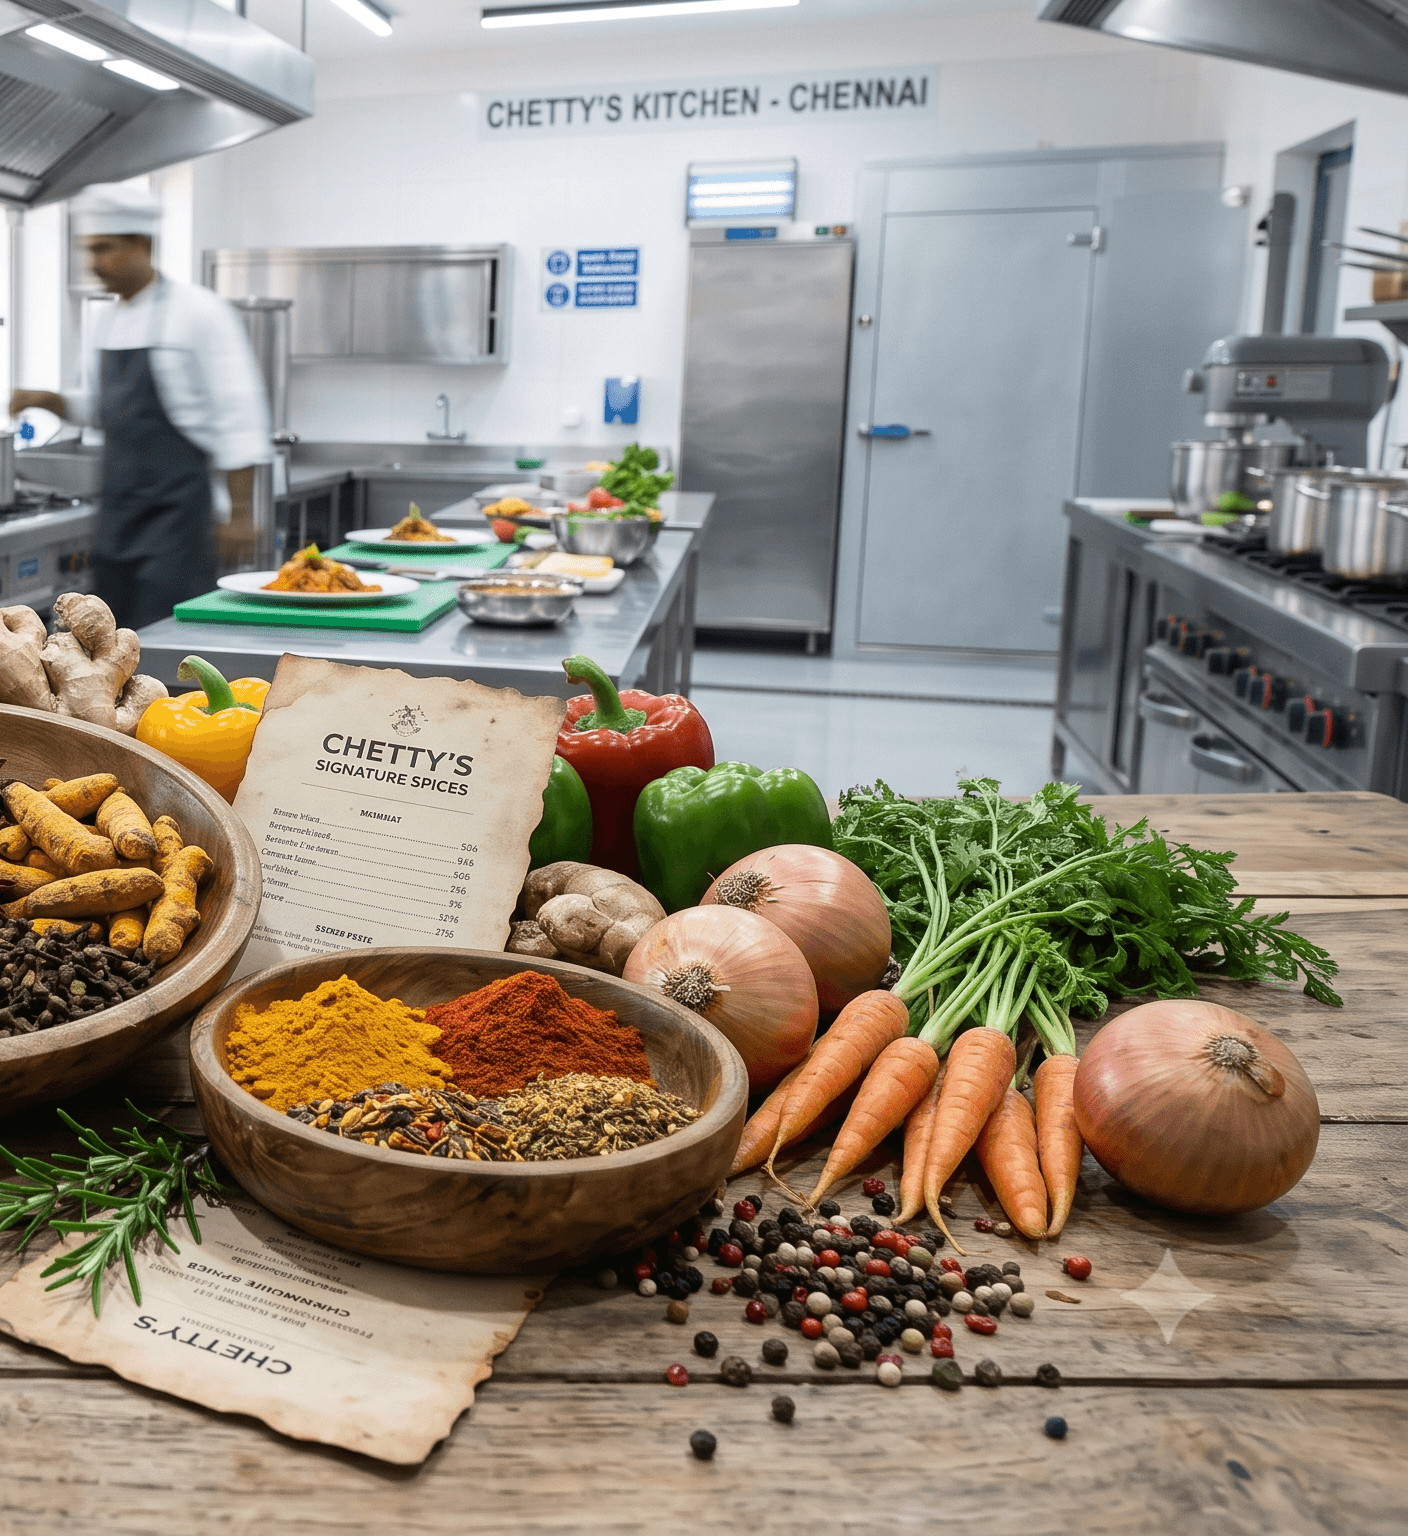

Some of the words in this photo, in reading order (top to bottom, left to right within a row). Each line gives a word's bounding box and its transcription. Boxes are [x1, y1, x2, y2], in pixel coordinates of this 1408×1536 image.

[486, 95, 622, 128] CHETTY'S
[633, 87, 760, 121] KITCHEN
[790, 77, 928, 113] CHENNAI
[315, 759, 408, 786] SIGNATURE
[410, 776, 469, 796] SPICES
[322, 733, 474, 776] CHETTY'S
[133, 1314, 293, 1375] CHETTY'S
